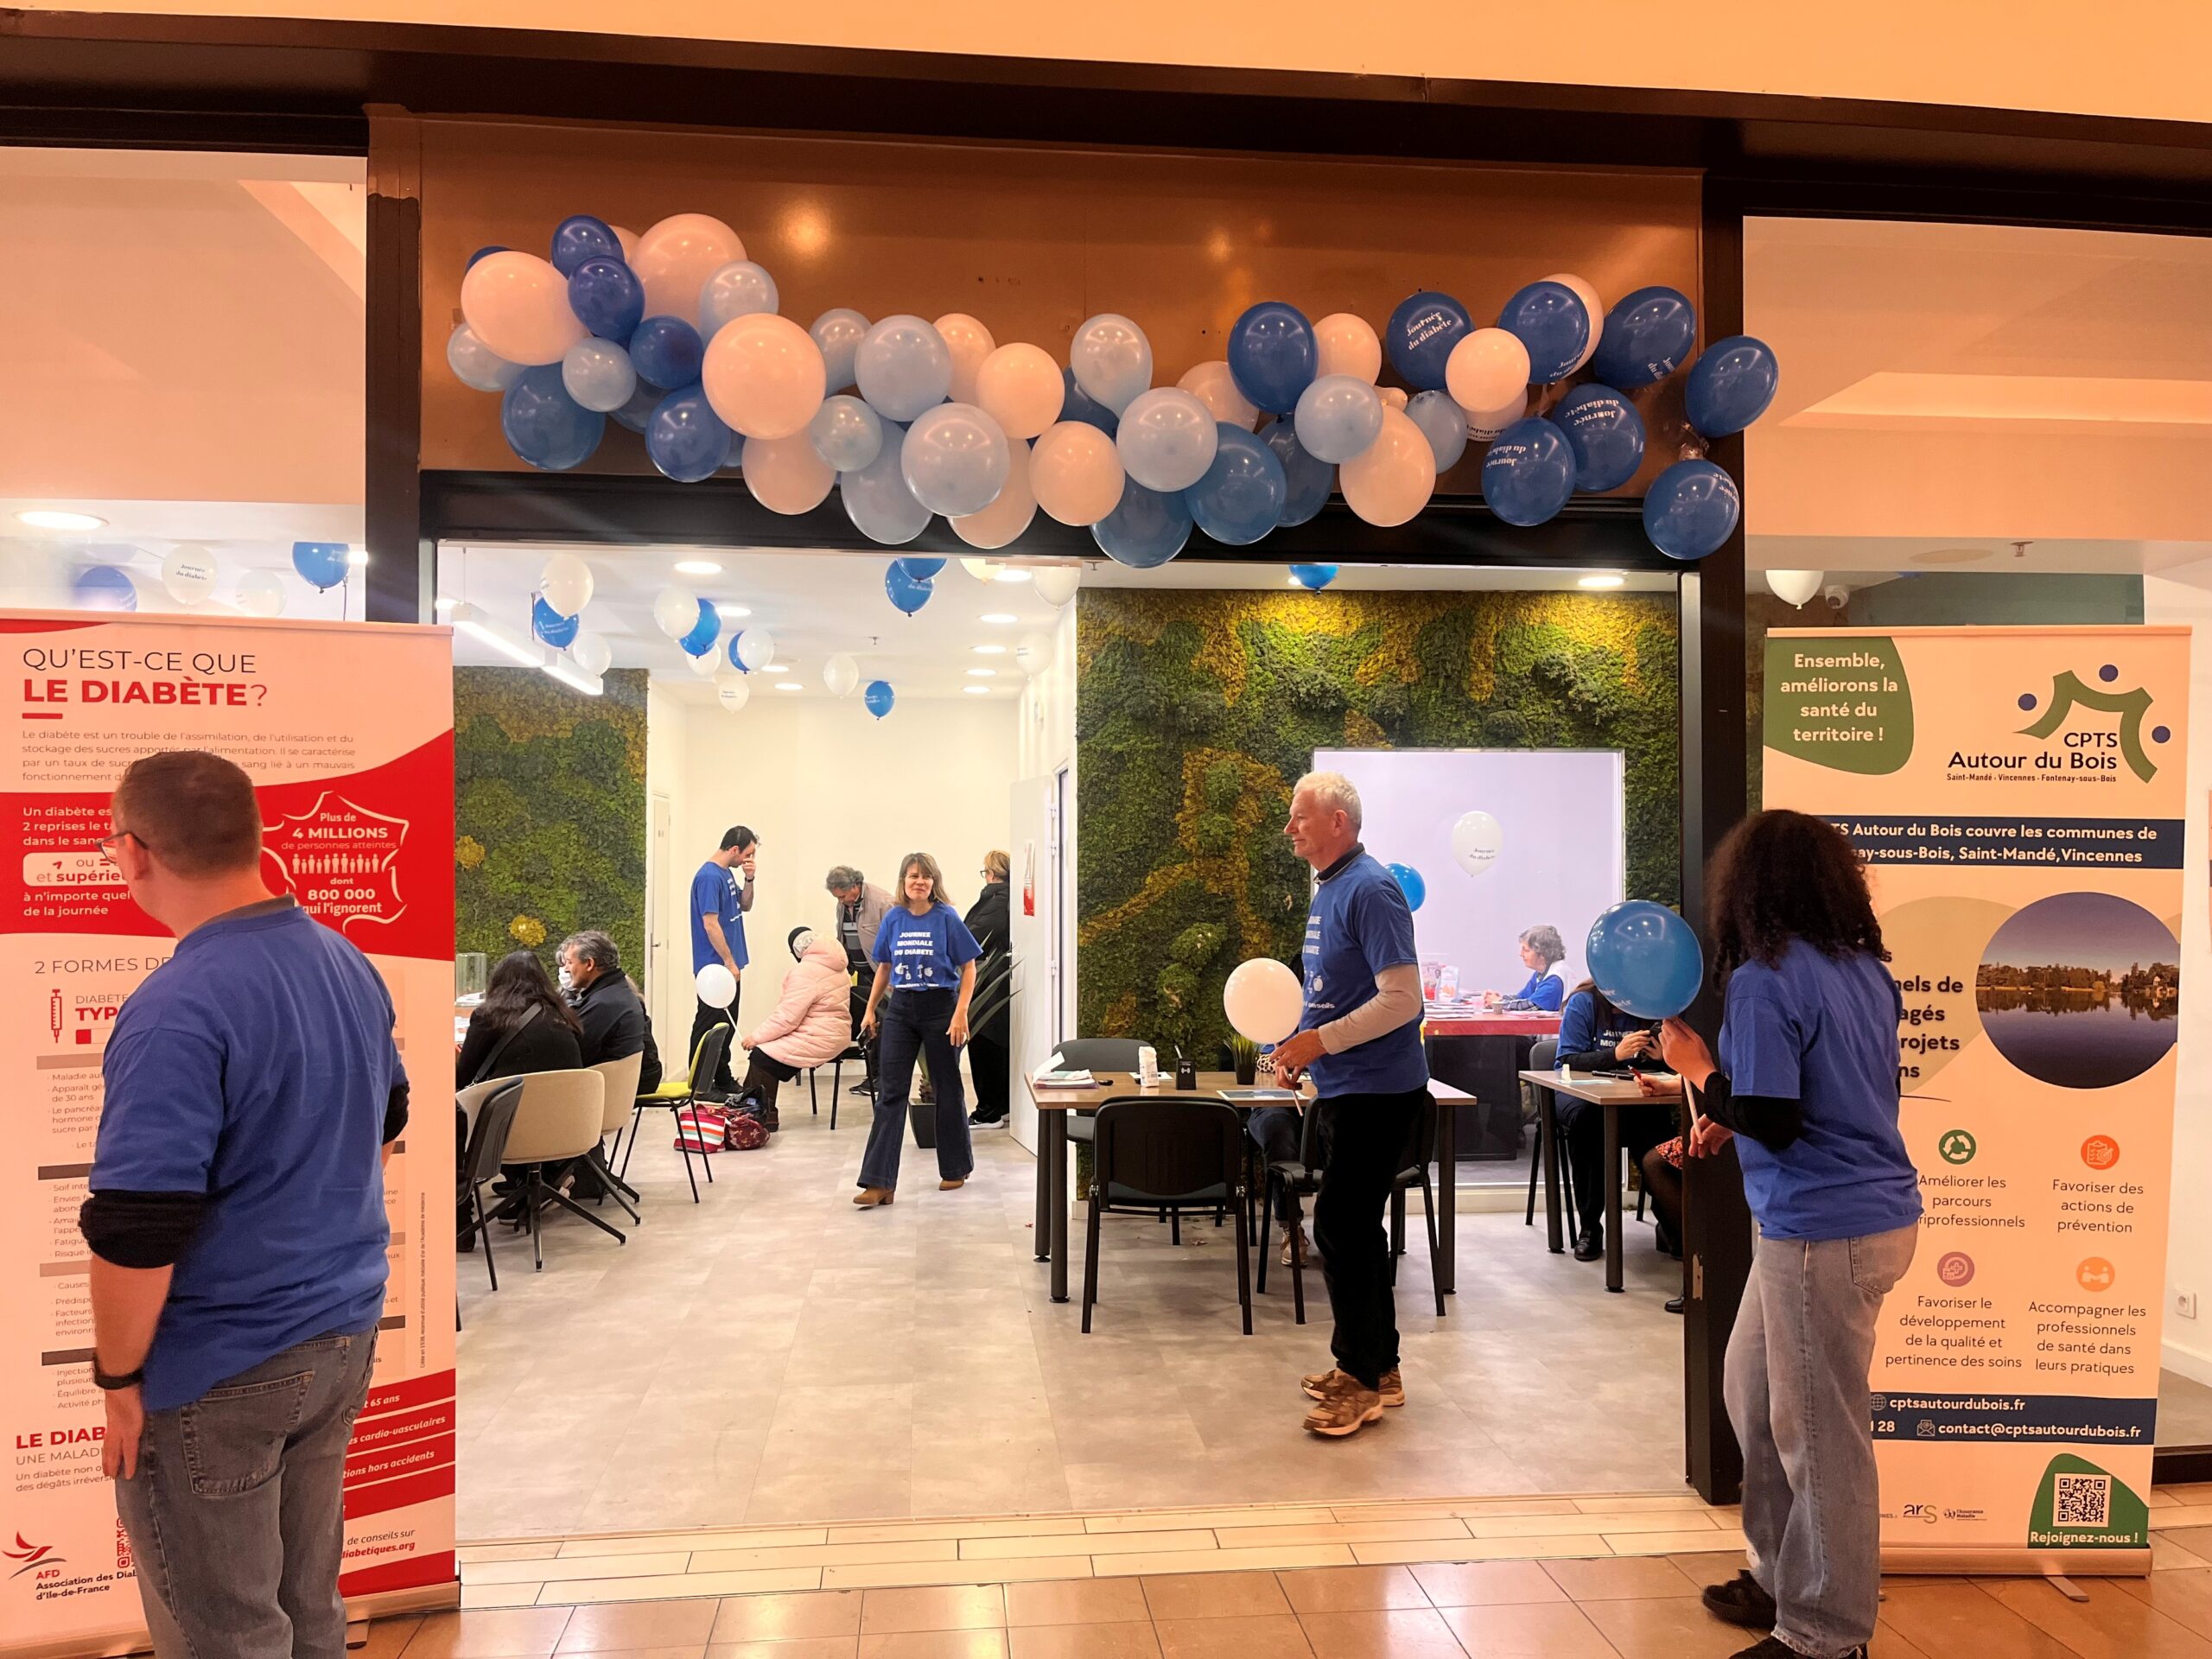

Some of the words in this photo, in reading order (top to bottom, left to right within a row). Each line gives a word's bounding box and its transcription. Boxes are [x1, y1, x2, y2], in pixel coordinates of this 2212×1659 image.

[1408, 340, 1420, 350] du
[1420, 320, 1452, 341] diabète
[22, 648, 182, 671] QU'EST-CE
[192, 653, 257, 675] QUE
[1794, 652, 1885, 670] Ensemble,
[24, 679, 68, 702] LE
[81, 676, 268, 707] DIABÈTE?
[1780, 677, 1878, 692] améliorons
[1883, 677, 1898, 692] la
[1800, 702, 1850, 717] santé
[1854, 702, 1878, 717] du
[22, 730, 35, 739] Le
[39, 730, 80, 740] diabète
[121, 731, 160, 740] trouble
[270, 734, 324, 742] l'utilisation
[340, 734, 353, 743] du
[1793, 727, 1874, 741] territoire
[2063, 732, 2118, 748] CPTS
[22, 744, 71, 754] stockage
[74, 744, 93, 753] des
[22, 760, 40, 768] par
[91, 758, 105, 766] de
[270, 760, 283, 768] lié
[1948, 751, 2027, 769] Autour
[2035, 751, 2062, 769] du
[2070, 752, 2117, 769] Bois
[22, 772, 112, 781] fonctionnement
[1947, 772, 1993, 781] Saint-Mandé
[1998, 773, 2036, 782] Vincennes
[2041, 773, 2117, 783] Fontenay-sous-Bois
[22, 807, 41, 817] Un
[45, 807, 95, 817] diabète
[320, 812, 341, 822] Plus
[344, 812, 356, 822] de
[22, 822, 30, 831] 2
[34, 822, 86, 832] reprises
[89, 822, 100, 830] le
[292, 828, 303, 839] 4
[308, 827, 388, 839] MILLIONS
[1853, 823, 1904, 836] Autour
[1907, 823, 1926, 836] du
[1930, 823, 1962, 837] Bois
[1966, 827, 2017, 837] couvre
[2020, 824, 2043, 838] les
[2046, 828, 2133, 840] communes
[2138, 826, 2158, 840] de
[22, 836, 54, 846] dans
[58, 836, 70, 846] le
[297, 842, 350, 850] personnes
[352, 841, 397, 849] atteintes
[76, 859, 94, 868] ou
[36, 873, 52, 882] et
[23, 893, 31, 902] à
[35, 891, 99, 903] n'importe
[308, 889, 340, 900] 800
[344, 889, 375, 900] 000
[23, 906, 40, 916] de
[44, 906, 54, 916] la
[57, 906, 109, 918] journée
[323, 902, 382, 916] l'ignorent
[35, 961, 45, 974] 2
[53, 958, 138, 973] FORMES
[1937, 976, 1963, 993] de
[75, 1007, 118, 1021] TYP
[1901, 1033, 1960, 1054] rojets
[1918, 1174, 1984, 1187] Améliorer
[1987, 1176, 2006, 1188] les
[2052, 1179, 2115, 1193] Favoriser
[2119, 1182, 2144, 1195] des
[1932, 1196, 1992, 1209] parcours
[2061, 1200, 2113, 1213] actions
[2116, 1201, 2134, 1214] de
[2057, 1219, 2133, 1233] prévention
[1917, 1295, 1977, 1309] Favoriser
[1980, 1297, 1993, 1309] le
[2029, 1301, 2125, 1319] Accompagner
[2127, 1305, 2147, 1317] les
[1899, 1314, 2005, 1331] développement
[2037, 1321, 2136, 1336] professionnels
[1905, 1334, 1923, 1346] de
[1926, 1334, 1937, 1346] la
[1941, 1335, 1986, 1351] qualité
[1988, 1338, 2003, 1348] et
[2037, 1339, 2054, 1351] de
[2057, 1342, 2096, 1354] santé
[2100, 1343, 2132, 1355] dans
[1885, 1354, 1957, 1368] pertinence
[1961, 1355, 1985, 1367] des
[1988, 1357, 2022, 1368] soins
[2035, 1358, 2067, 1371] leurs
[2070, 1362, 2134, 1376] pratiques
[370, 1398, 382, 1408] 65
[383, 1395, 400, 1405] ans
[1890, 1398, 2026, 1411] cptsautourdubois.fr
[359, 1416, 446, 1442] cardio-vasculaires
[1878, 1421, 1895, 1433] 28
[1938, 1422, 2141, 1438] contact@cptsautourdubois.fr
[16, 1433, 42, 1449] LE
[50, 1427, 106, 1446] DIAB
[16, 1453, 46, 1465] UNE
[368, 1462, 389, 1473] hors
[390, 1451, 435, 1467] accidents
[16, 1472, 30, 1481] Un
[33, 1468, 71, 1479] diabète
[16, 1484, 34, 1492] des
[36, 1479, 71, 1490] dégâts
[346, 1536, 359, 1545] de
[361, 1531, 398, 1543] conseils
[400, 1529, 416, 1538] sur
[2031, 1531, 2131, 1546] Rejoignez-nous
[35, 1569, 60, 1580] AFD
[35, 1576, 92, 1590] Association
[96, 1573, 113, 1582] des
